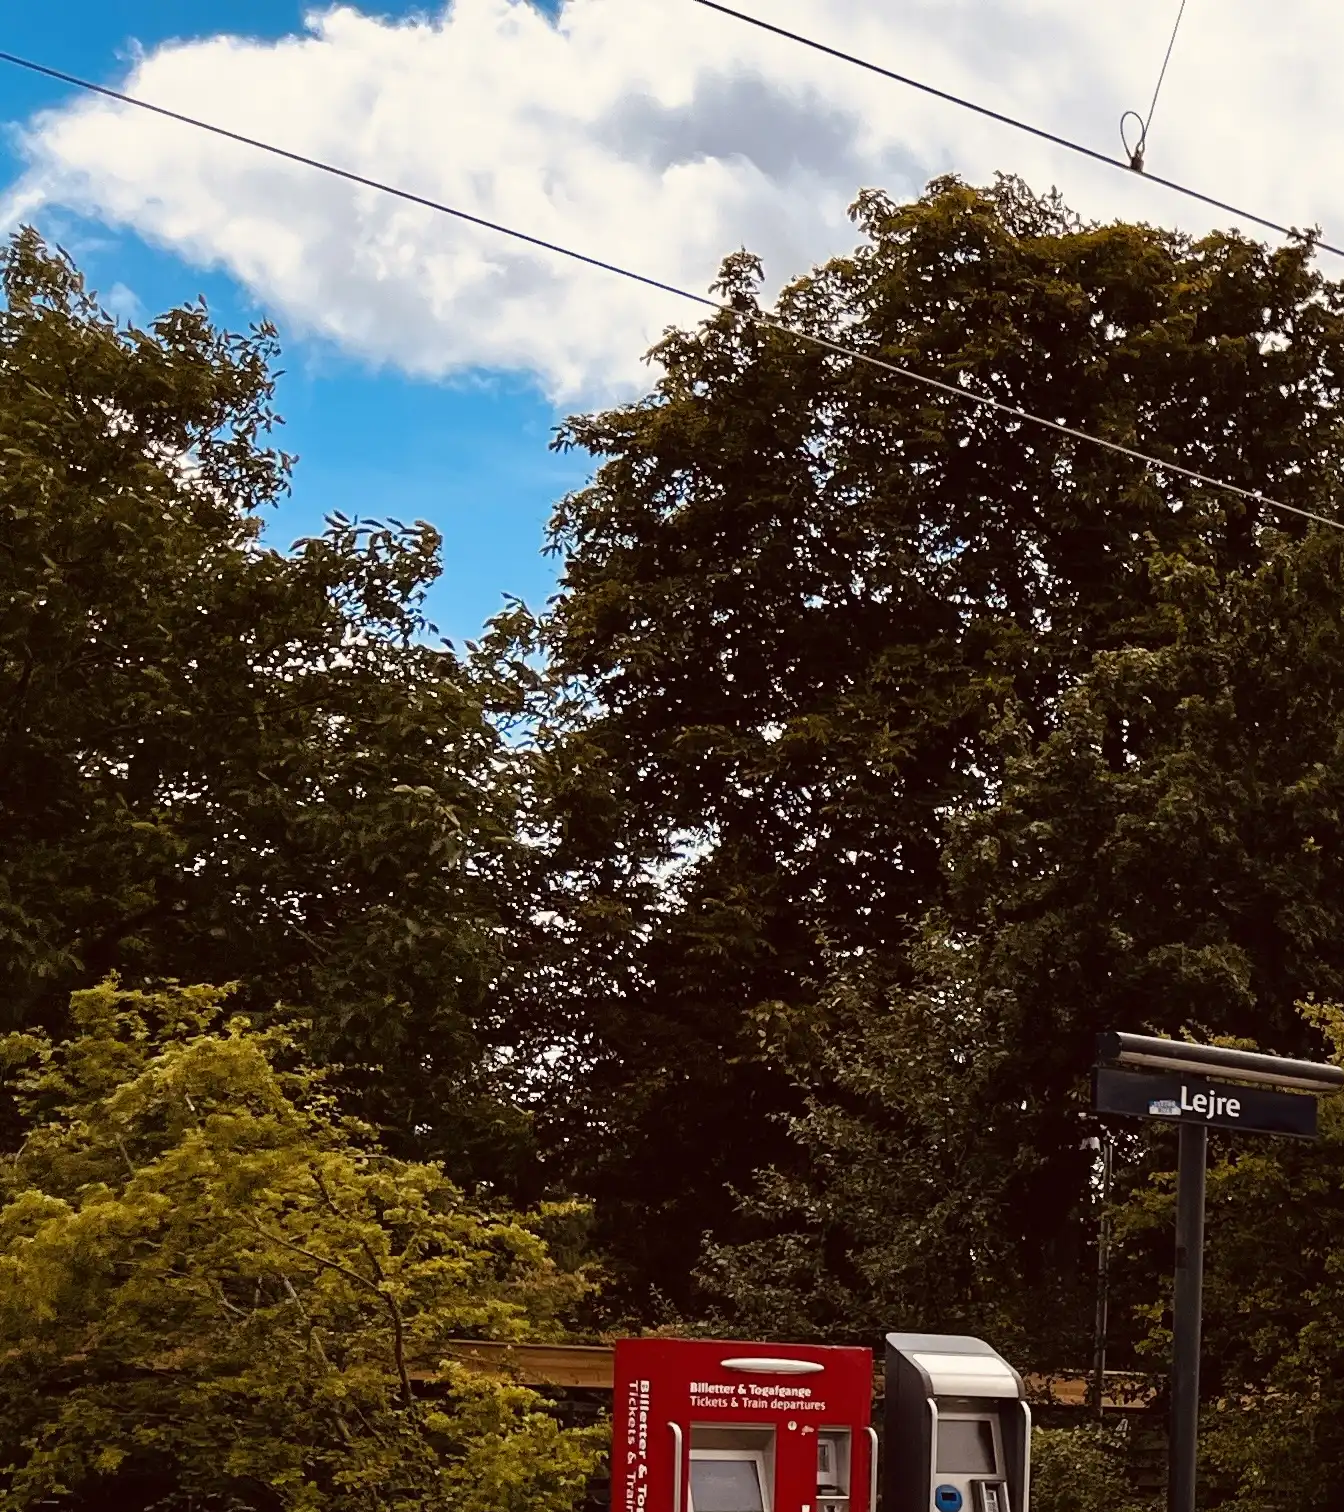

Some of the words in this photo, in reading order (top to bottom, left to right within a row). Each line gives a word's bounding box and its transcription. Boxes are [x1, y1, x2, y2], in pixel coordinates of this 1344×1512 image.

[1181, 1085, 1240, 1119] Lejre
[690, 1382, 735, 1394] Billetter
[738, 1384, 746, 1394] &
[749, 1384, 811, 1398] Togafgange
[690, 1396, 728, 1408] Tickets
[730, 1397, 738, 1407] &
[742, 1397, 768, 1408] Train
[770, 1398, 825, 1411] departures
[628, 1380, 639, 1445] Tickets
[638, 1380, 650, 1460] Billetter
[627, 1451, 636, 1464] &
[638, 1464, 647, 1478] &
